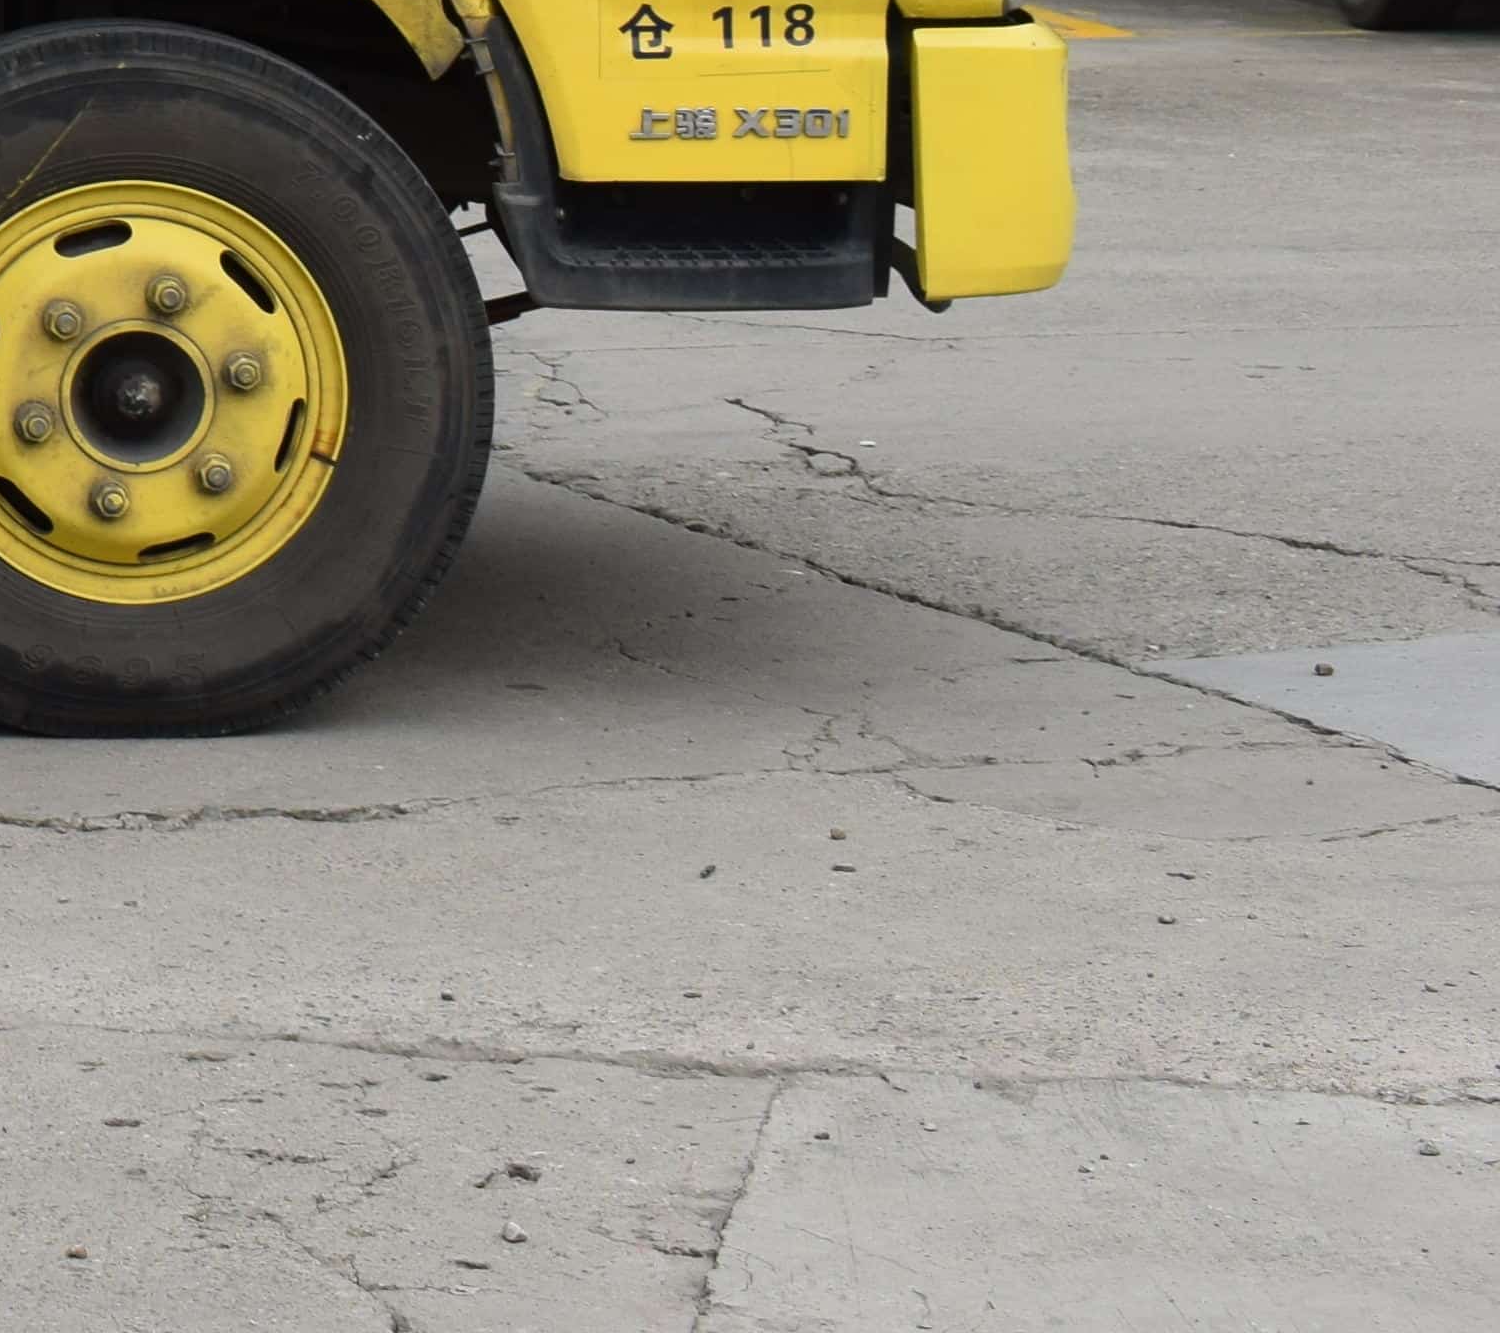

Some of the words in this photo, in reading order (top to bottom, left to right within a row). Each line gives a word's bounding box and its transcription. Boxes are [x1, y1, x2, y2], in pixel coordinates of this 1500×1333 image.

[619, 3, 674, 60] 仓
[712, 3, 815, 49] 118
[732, 108, 850, 139] X301
